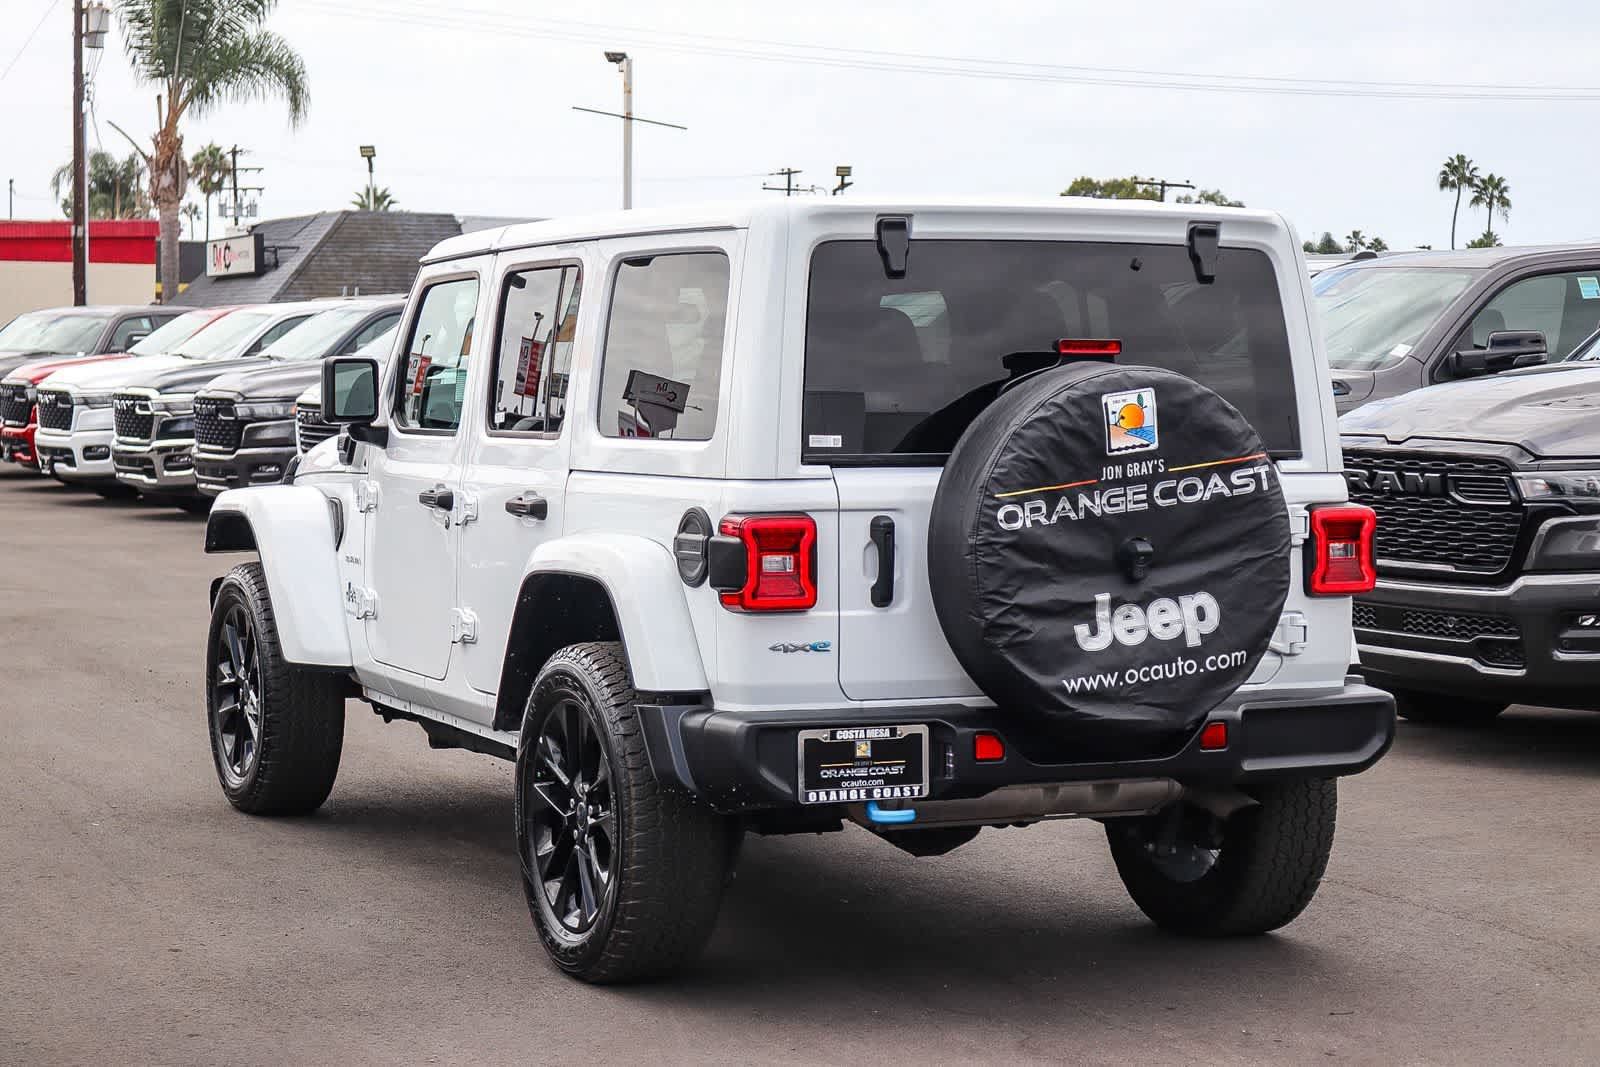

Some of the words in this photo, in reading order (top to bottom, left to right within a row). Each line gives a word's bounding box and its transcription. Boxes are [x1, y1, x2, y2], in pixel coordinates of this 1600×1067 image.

[1101, 465, 1122, 480] JON
[1127, 459, 1165, 477] GRAY'S
[1343, 468, 1442, 497] RAM
[997, 484, 1148, 531] ORANGE
[1153, 464, 1270, 506] COAST
[1073, 591, 1221, 651] Jeep
[1062, 650, 1247, 694] www.ocauto.com
[836, 730, 865, 740] COSTA
[866, 728, 890, 738] MESA
[820, 767, 868, 778] ORANGE
[869, 765, 905, 776] COAST
[808, 790, 867, 802] ORANGE
[873, 786, 920, 798] COAST
[841, 779, 884, 788] ocauto.com
